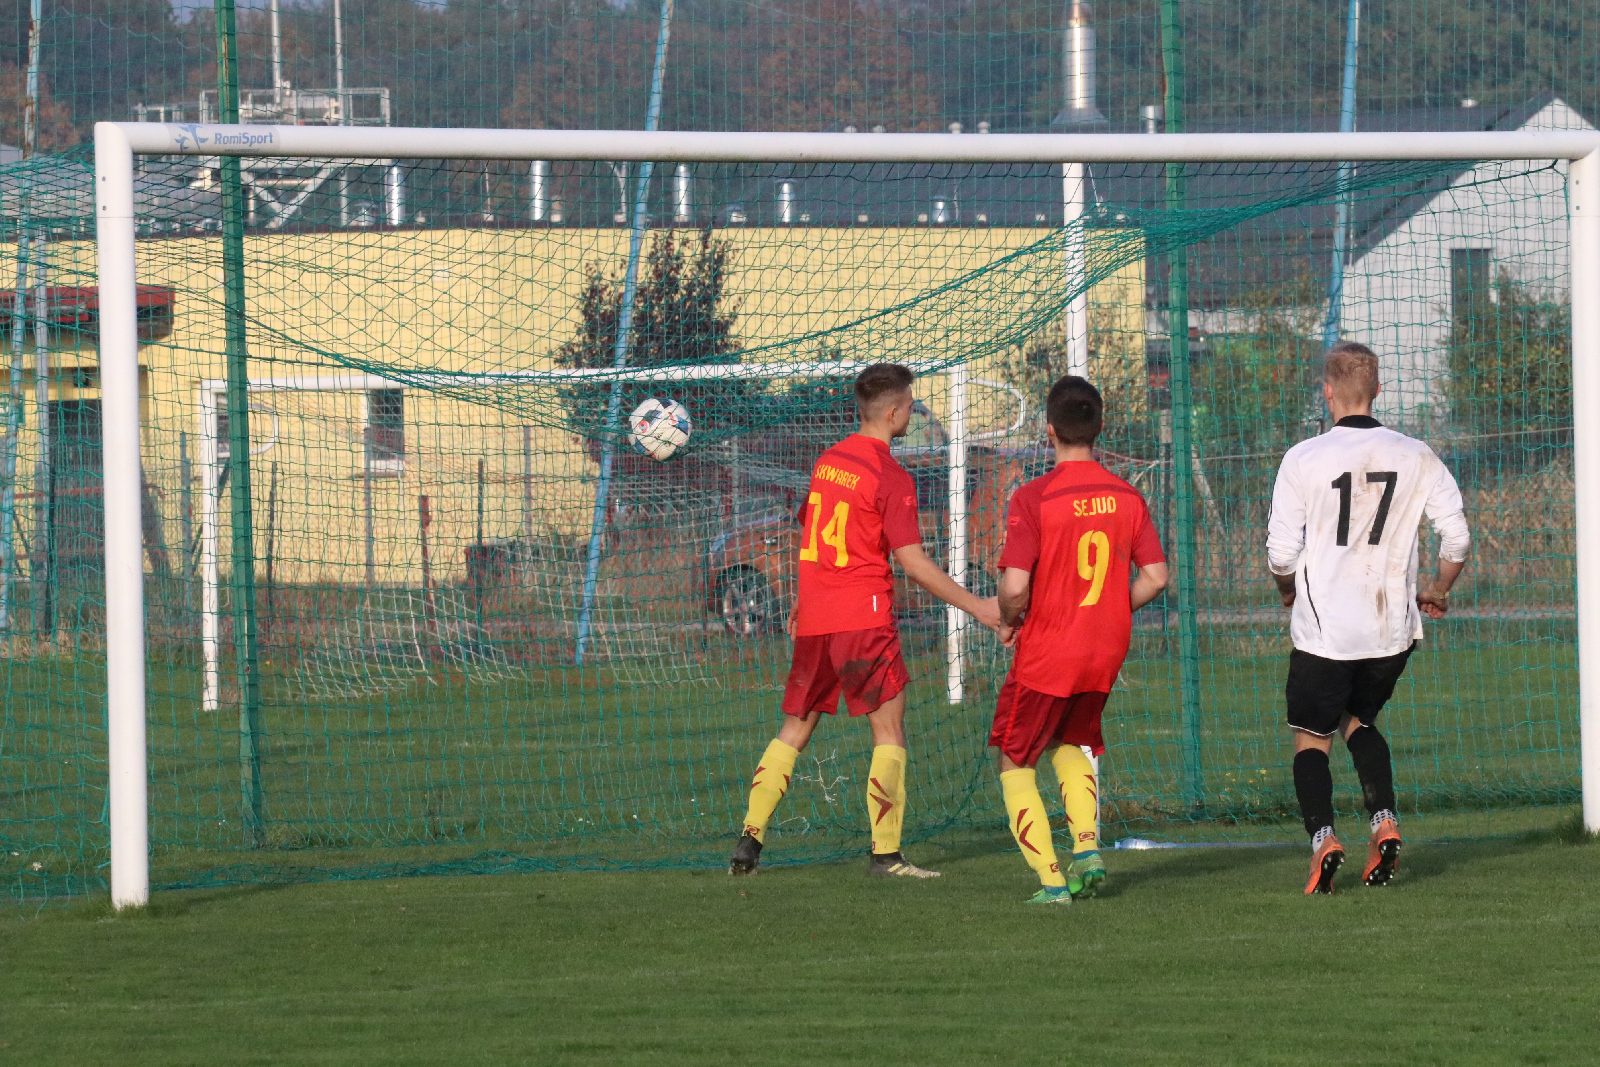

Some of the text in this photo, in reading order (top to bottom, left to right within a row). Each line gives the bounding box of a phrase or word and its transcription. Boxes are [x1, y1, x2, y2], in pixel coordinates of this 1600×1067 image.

[214, 132, 273, 147] RomiSport
[799, 491, 850, 568] 14
[1331, 471, 1398, 547] 17
[1077, 529, 1110, 607] 9
